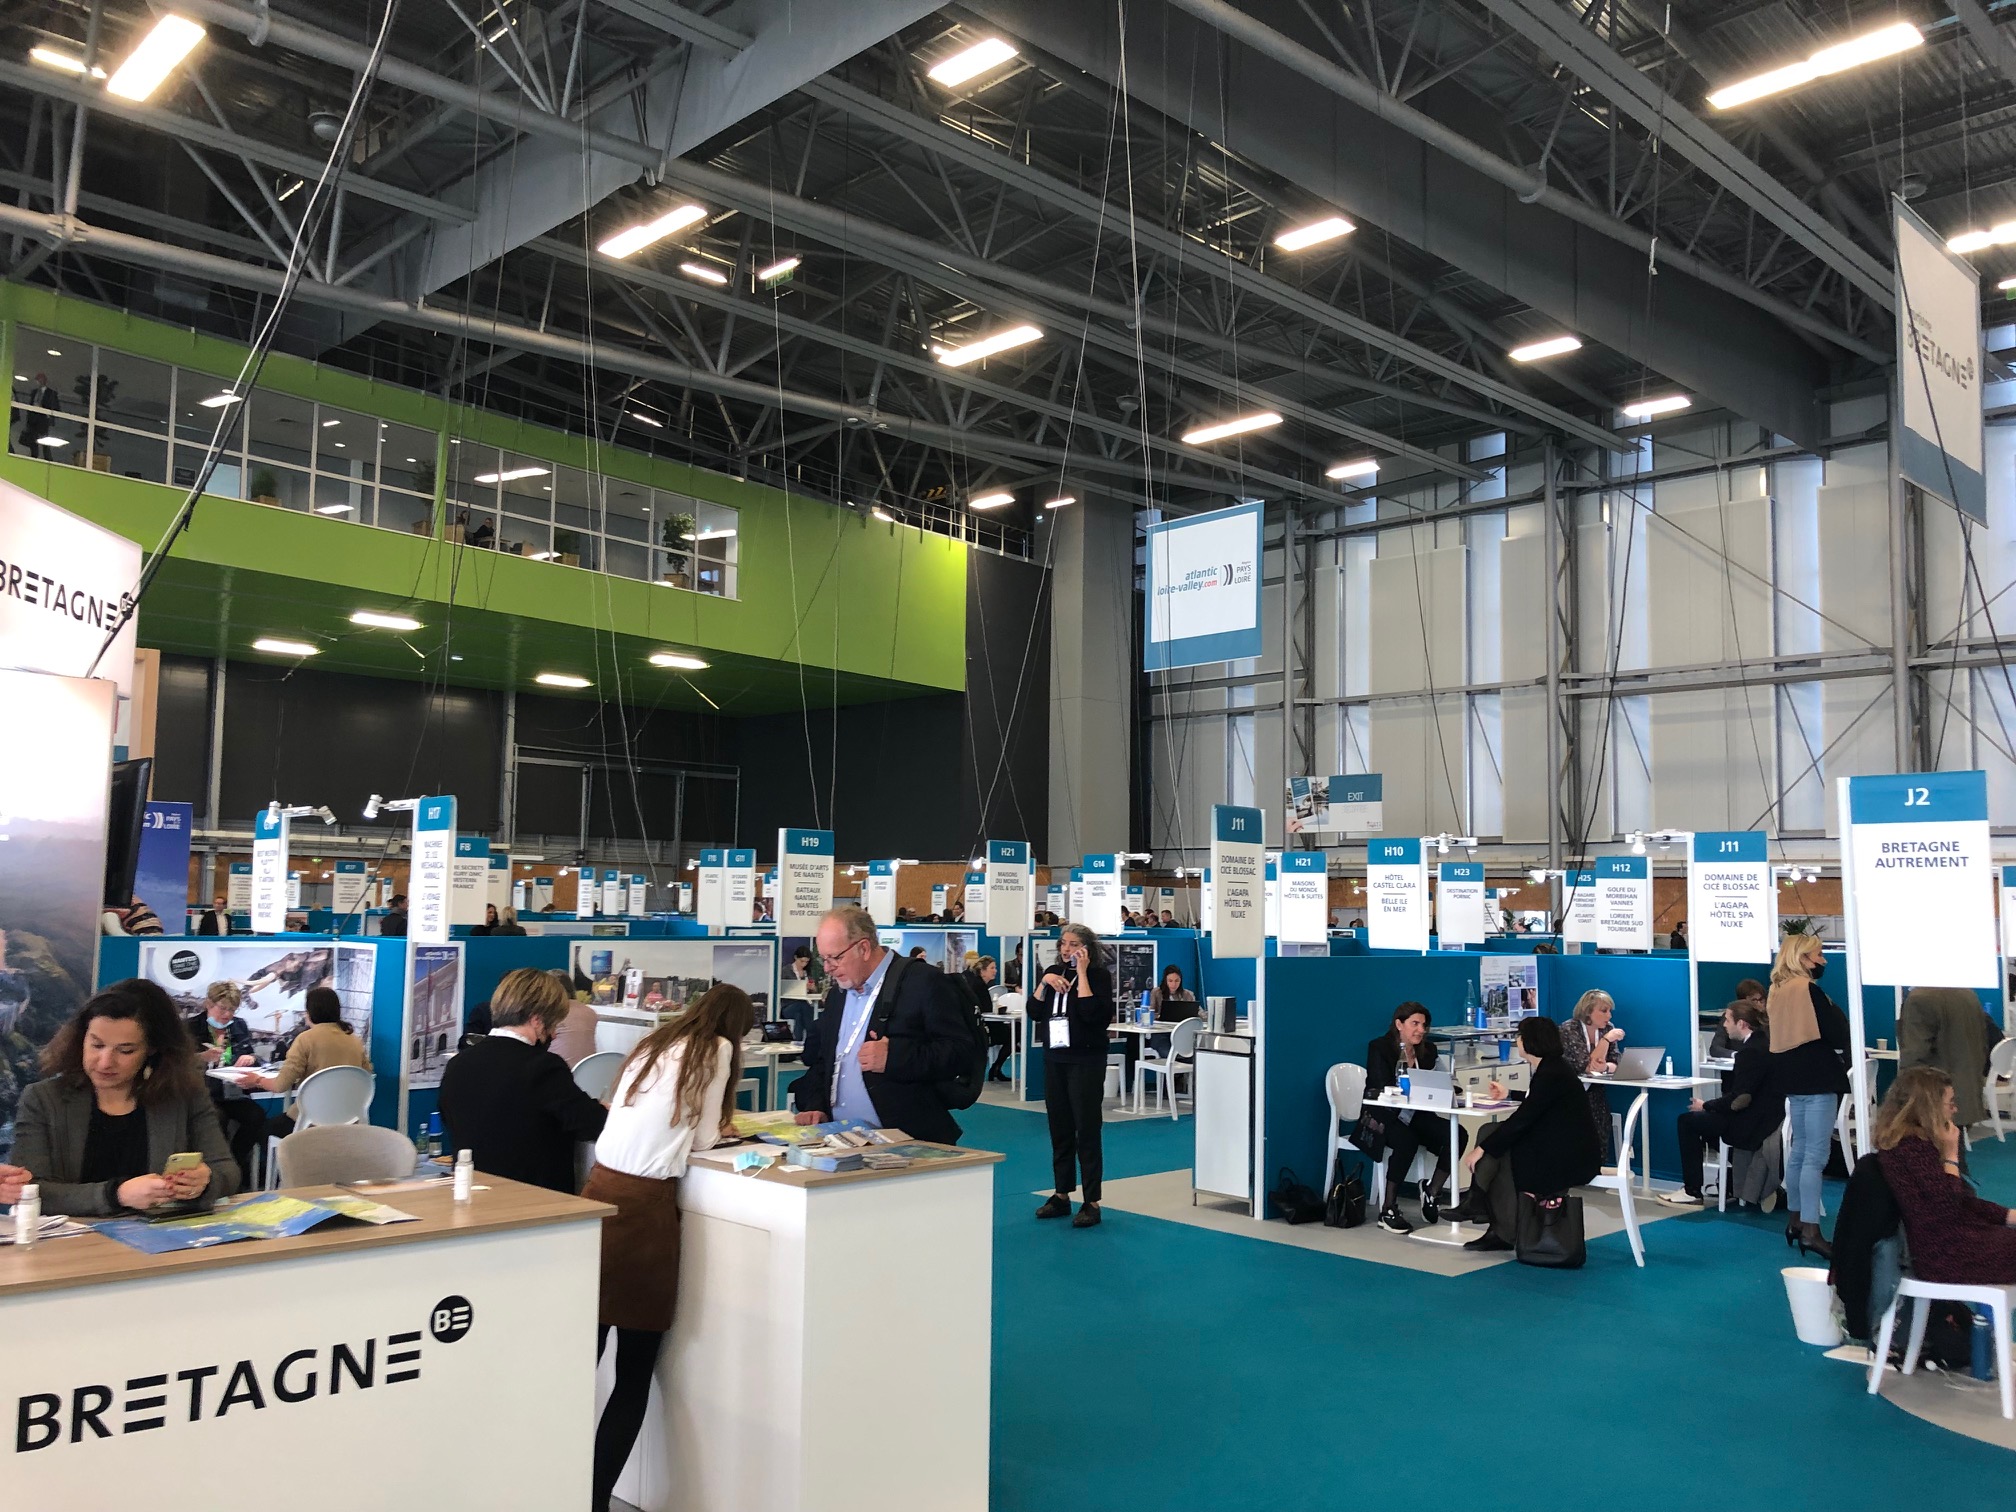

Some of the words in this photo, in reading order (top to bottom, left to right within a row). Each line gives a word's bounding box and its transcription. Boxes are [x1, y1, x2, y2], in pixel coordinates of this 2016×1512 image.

[1185, 566, 1218, 581] atlantic
[1236, 564, 1252, 574] PAYS
[1234, 575, 1251, 584] LOIRE
[1157, 579, 1218, 596] loire-valley.com
[0, 559, 118, 633] BRETAGNE
[1347, 792, 1364, 801] EXIT
[1904, 787, 1931, 806] J2
[1231, 817, 1245, 831] J11
[801, 837, 819, 848] H19
[1719, 841, 1739, 852] J11
[1881, 841, 1960, 853] BRETAGNE
[1001, 848, 1015, 856] H21
[1384, 846, 1404, 857] H10
[1093, 860, 1105, 868] G14
[1221, 855, 1247, 865] DOMAINE
[1248, 857, 1255, 865] DE
[1295, 858, 1311, 867] H21
[1874, 856, 1969, 868] AUTREMENT
[789, 863, 808, 871] MUSÉE
[1233, 867, 1256, 876] BLOSSAC
[1454, 868, 1470, 876] H23
[1612, 863, 1631, 872] H12
[1577, 874, 1592, 882] H25
[1224, 898, 1242, 908] HÔTEL
[1242, 900, 1252, 908] SPA
[1230, 910, 1246, 918] NUXE
[1710, 910, 1736, 918] HÔTEL
[15, 1329, 423, 1454] BRETAGNE
